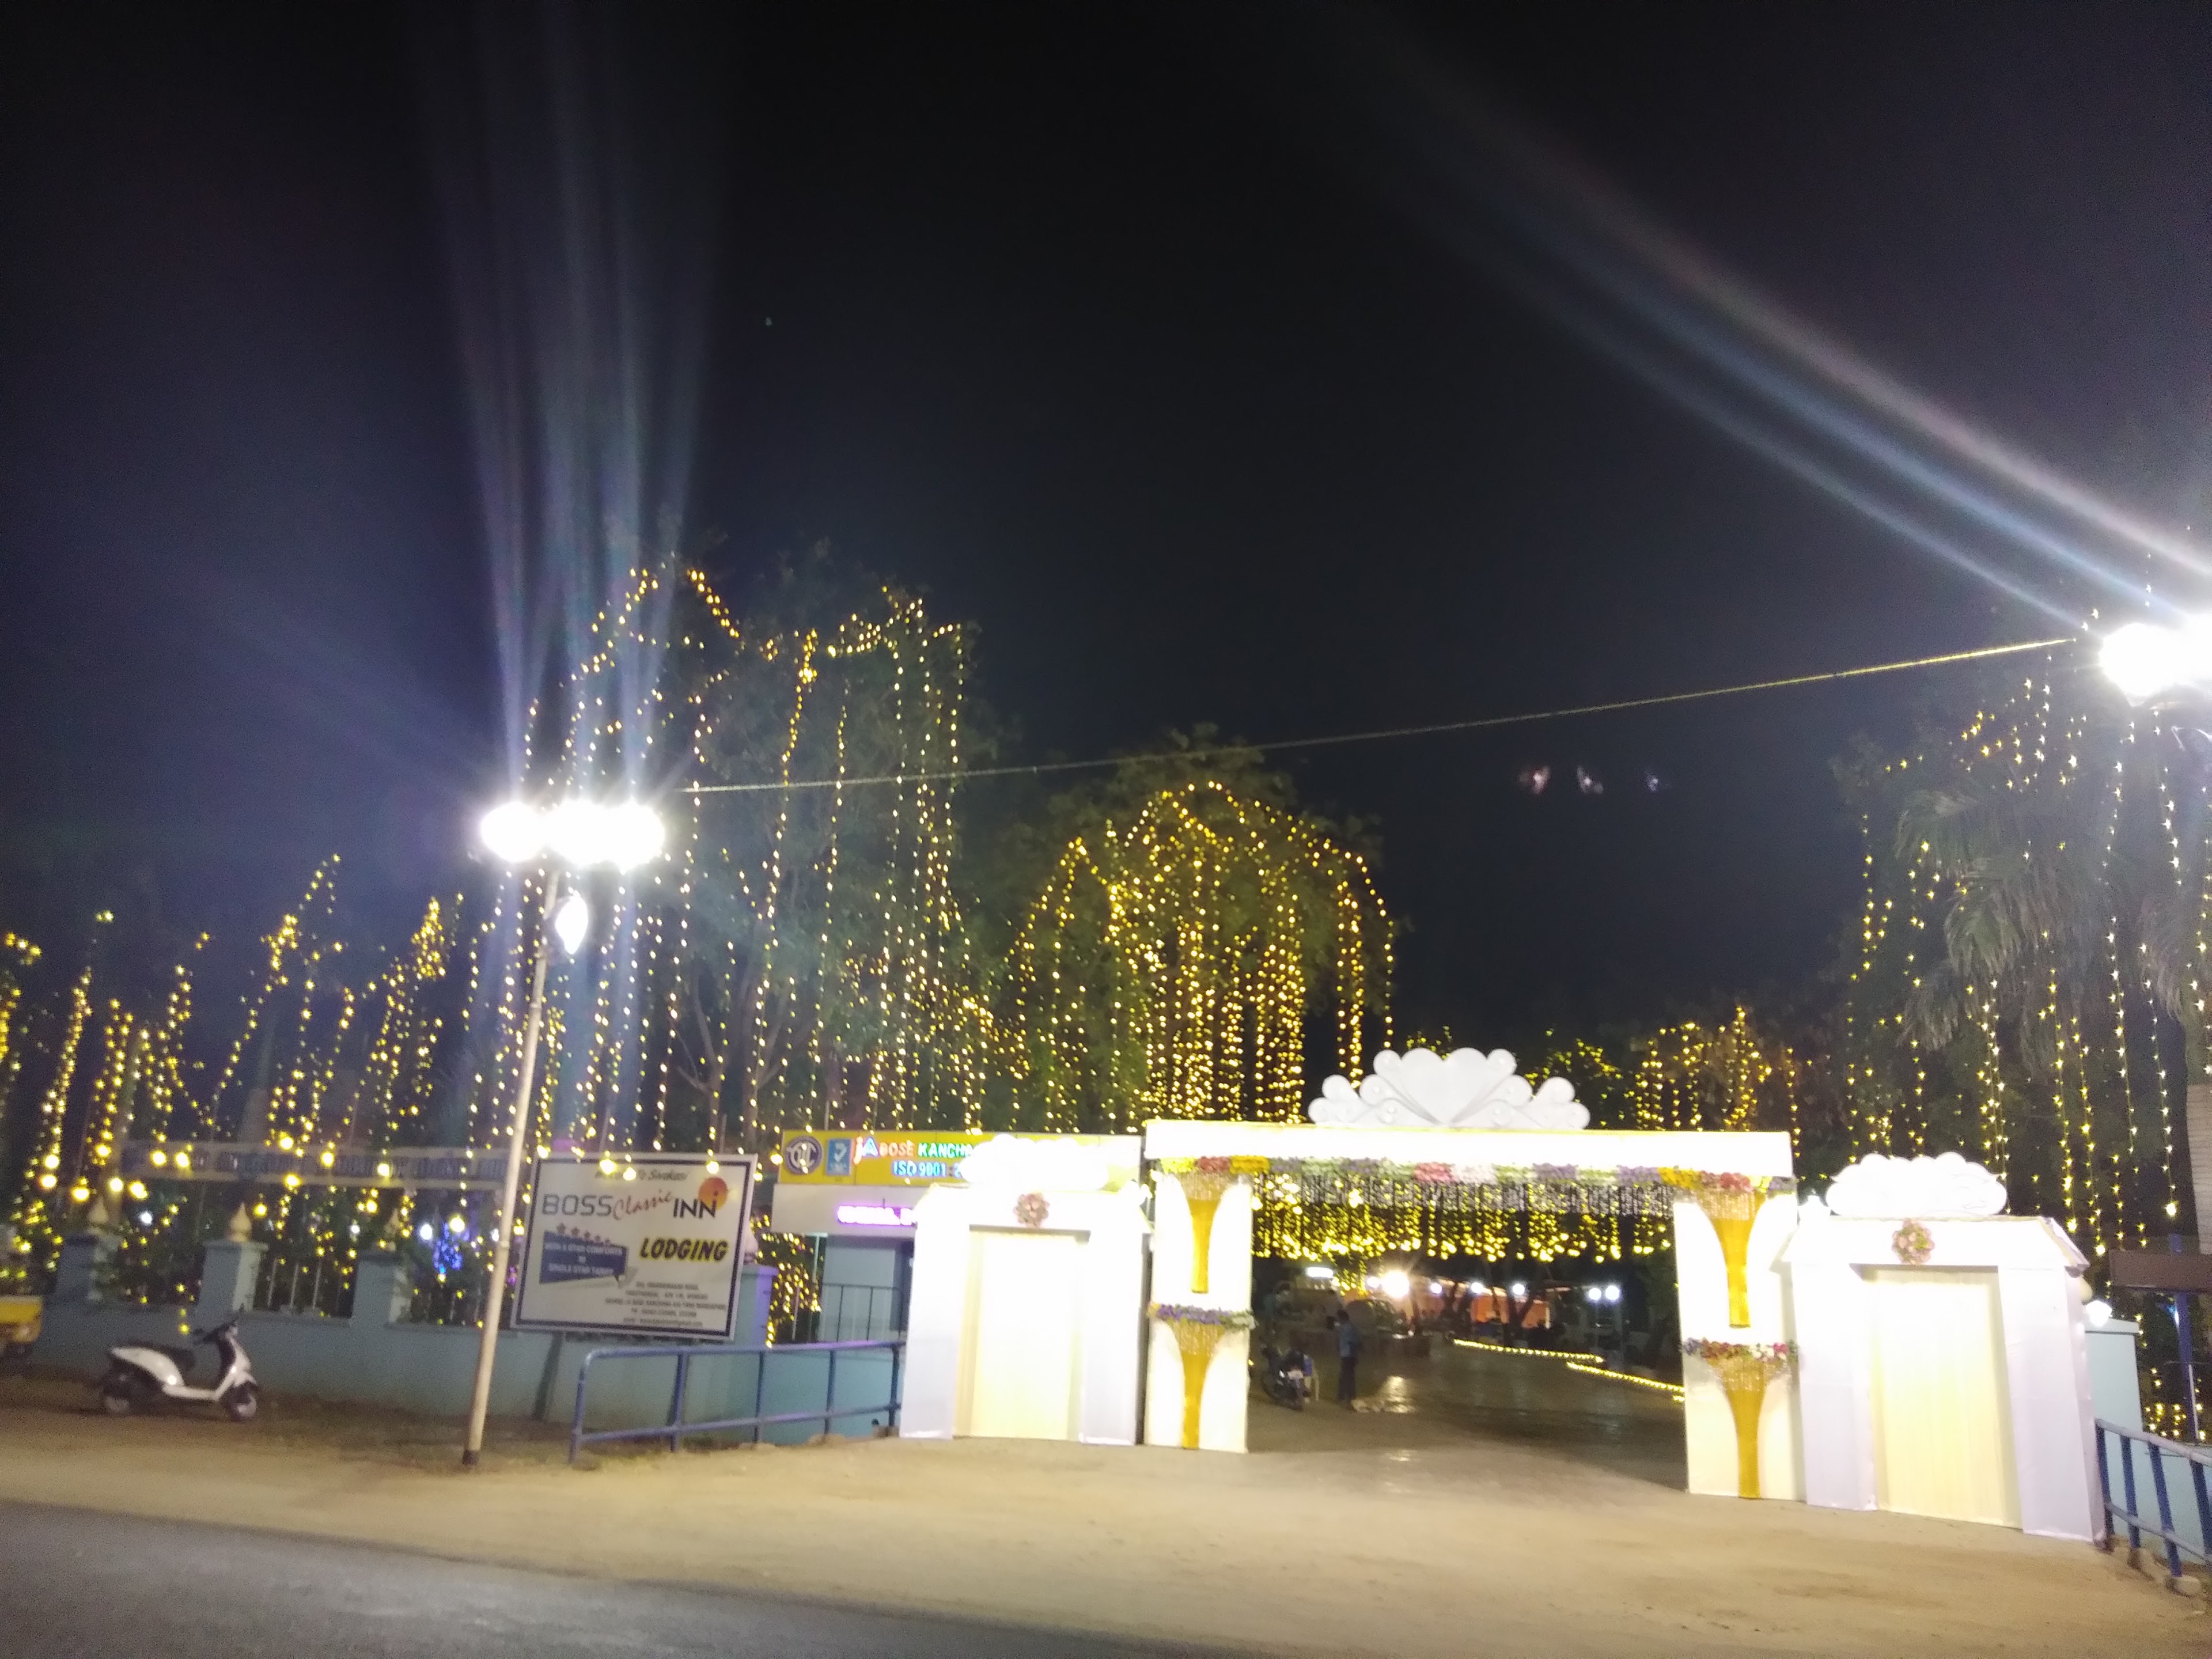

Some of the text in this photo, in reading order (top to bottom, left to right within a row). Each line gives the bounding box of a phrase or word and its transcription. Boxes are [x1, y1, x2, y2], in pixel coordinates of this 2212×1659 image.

[893, 1160, 918, 1176] ISO
[918, 1161, 947, 1177] 9001
[542, 1194, 613, 1217] BOSS
[613, 1188, 672, 1220] Classic
[640, 1237, 728, 1262] LODGING
